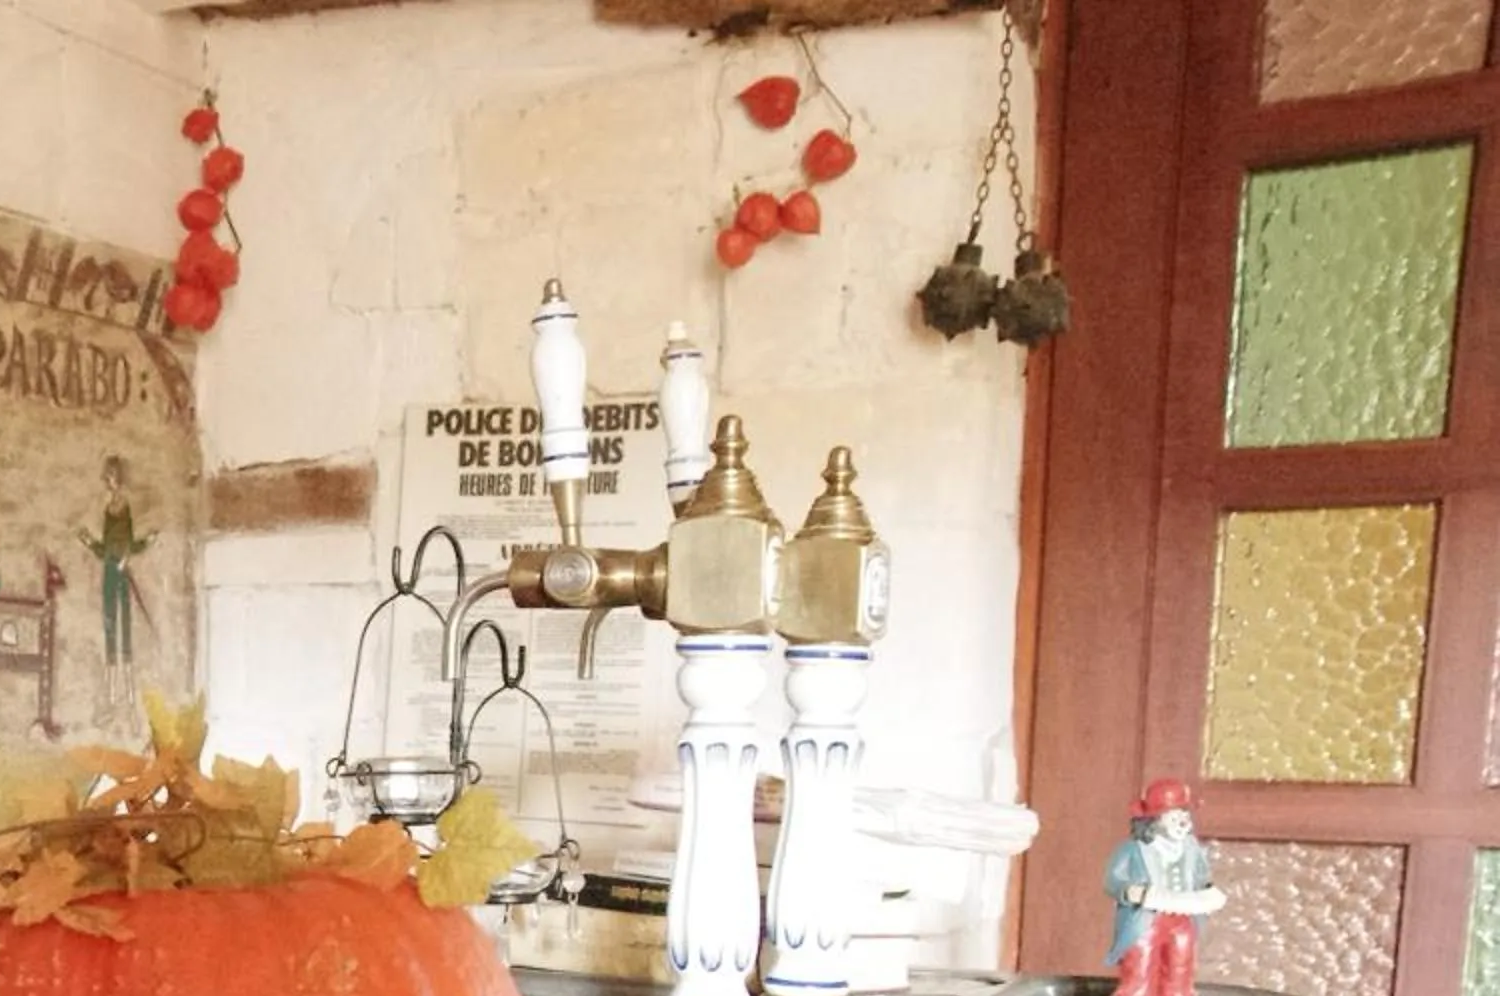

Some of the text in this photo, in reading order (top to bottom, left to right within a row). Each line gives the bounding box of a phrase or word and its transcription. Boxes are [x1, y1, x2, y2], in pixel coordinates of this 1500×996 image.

[426, 407, 513, 436] POLICE
[458, 440, 491, 468] DE
[459, 473, 513, 496] HEURES
[519, 473, 536, 496] DE
